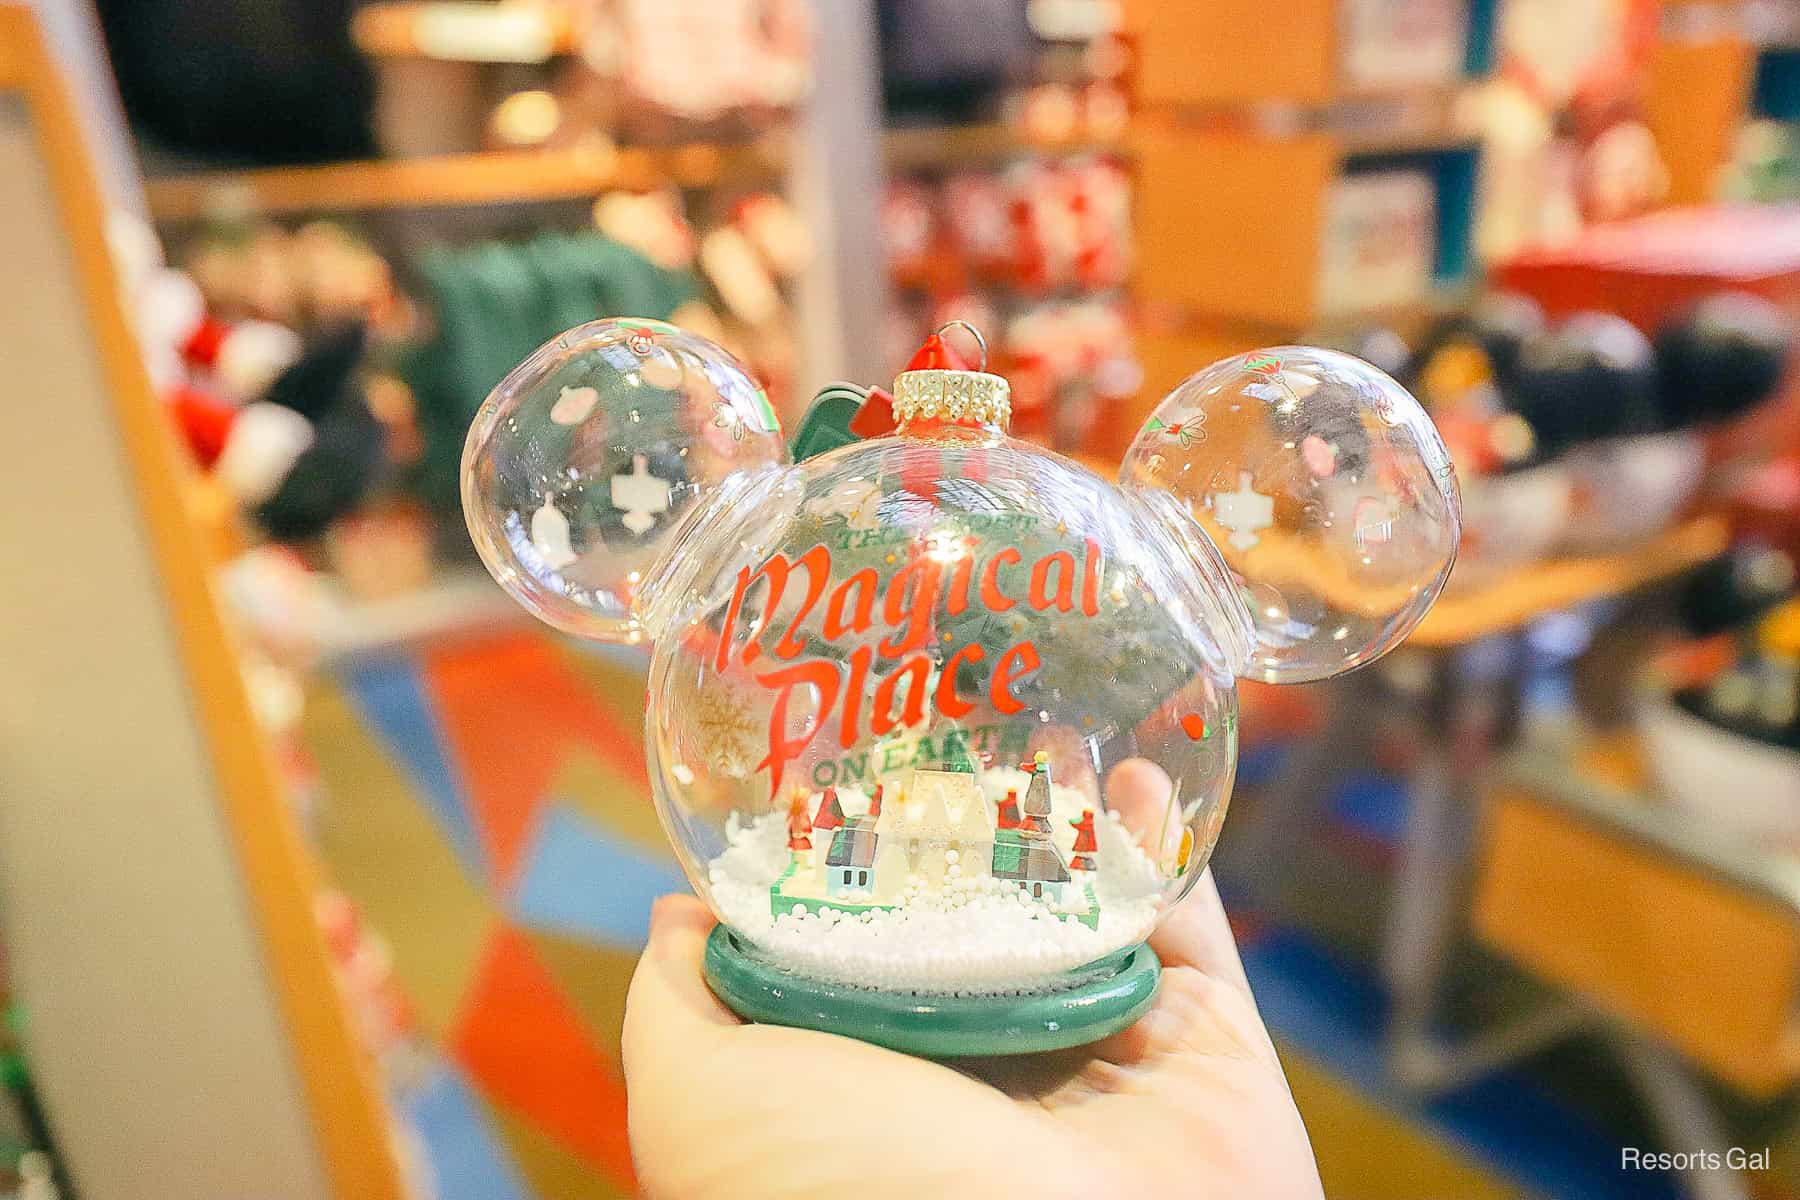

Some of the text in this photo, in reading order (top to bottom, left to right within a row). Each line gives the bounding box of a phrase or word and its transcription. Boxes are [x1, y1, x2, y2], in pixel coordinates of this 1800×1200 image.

[715, 537, 1101, 674] Magical
[755, 640, 1041, 800] Place
[812, 752, 869, 788] ON
